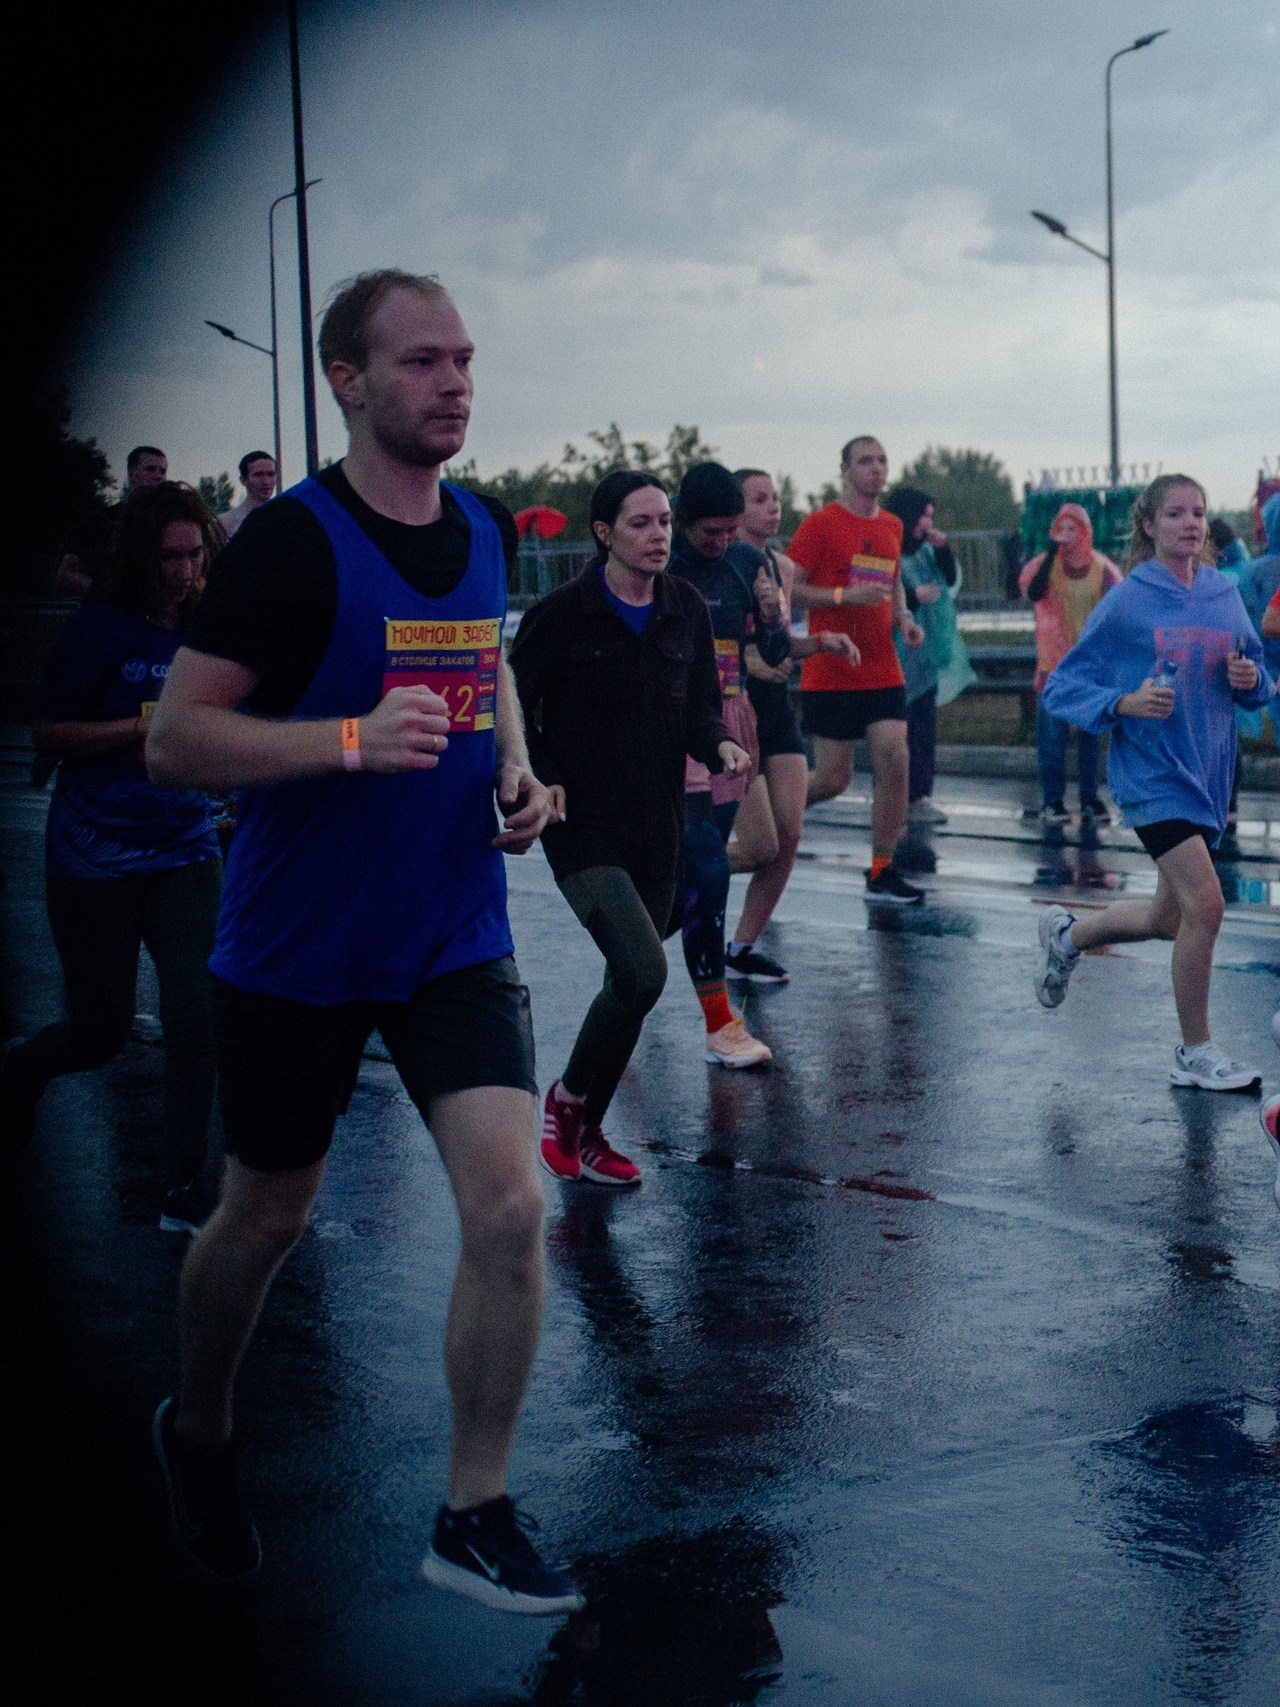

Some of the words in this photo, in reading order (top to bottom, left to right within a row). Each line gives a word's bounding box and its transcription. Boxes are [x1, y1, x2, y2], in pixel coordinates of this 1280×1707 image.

[392, 625, 456, 644] НОЧНОЙ
[462, 623, 497, 644] ЗАБЕГ
[439, 655, 475, 665] ЗАКАТОВ
